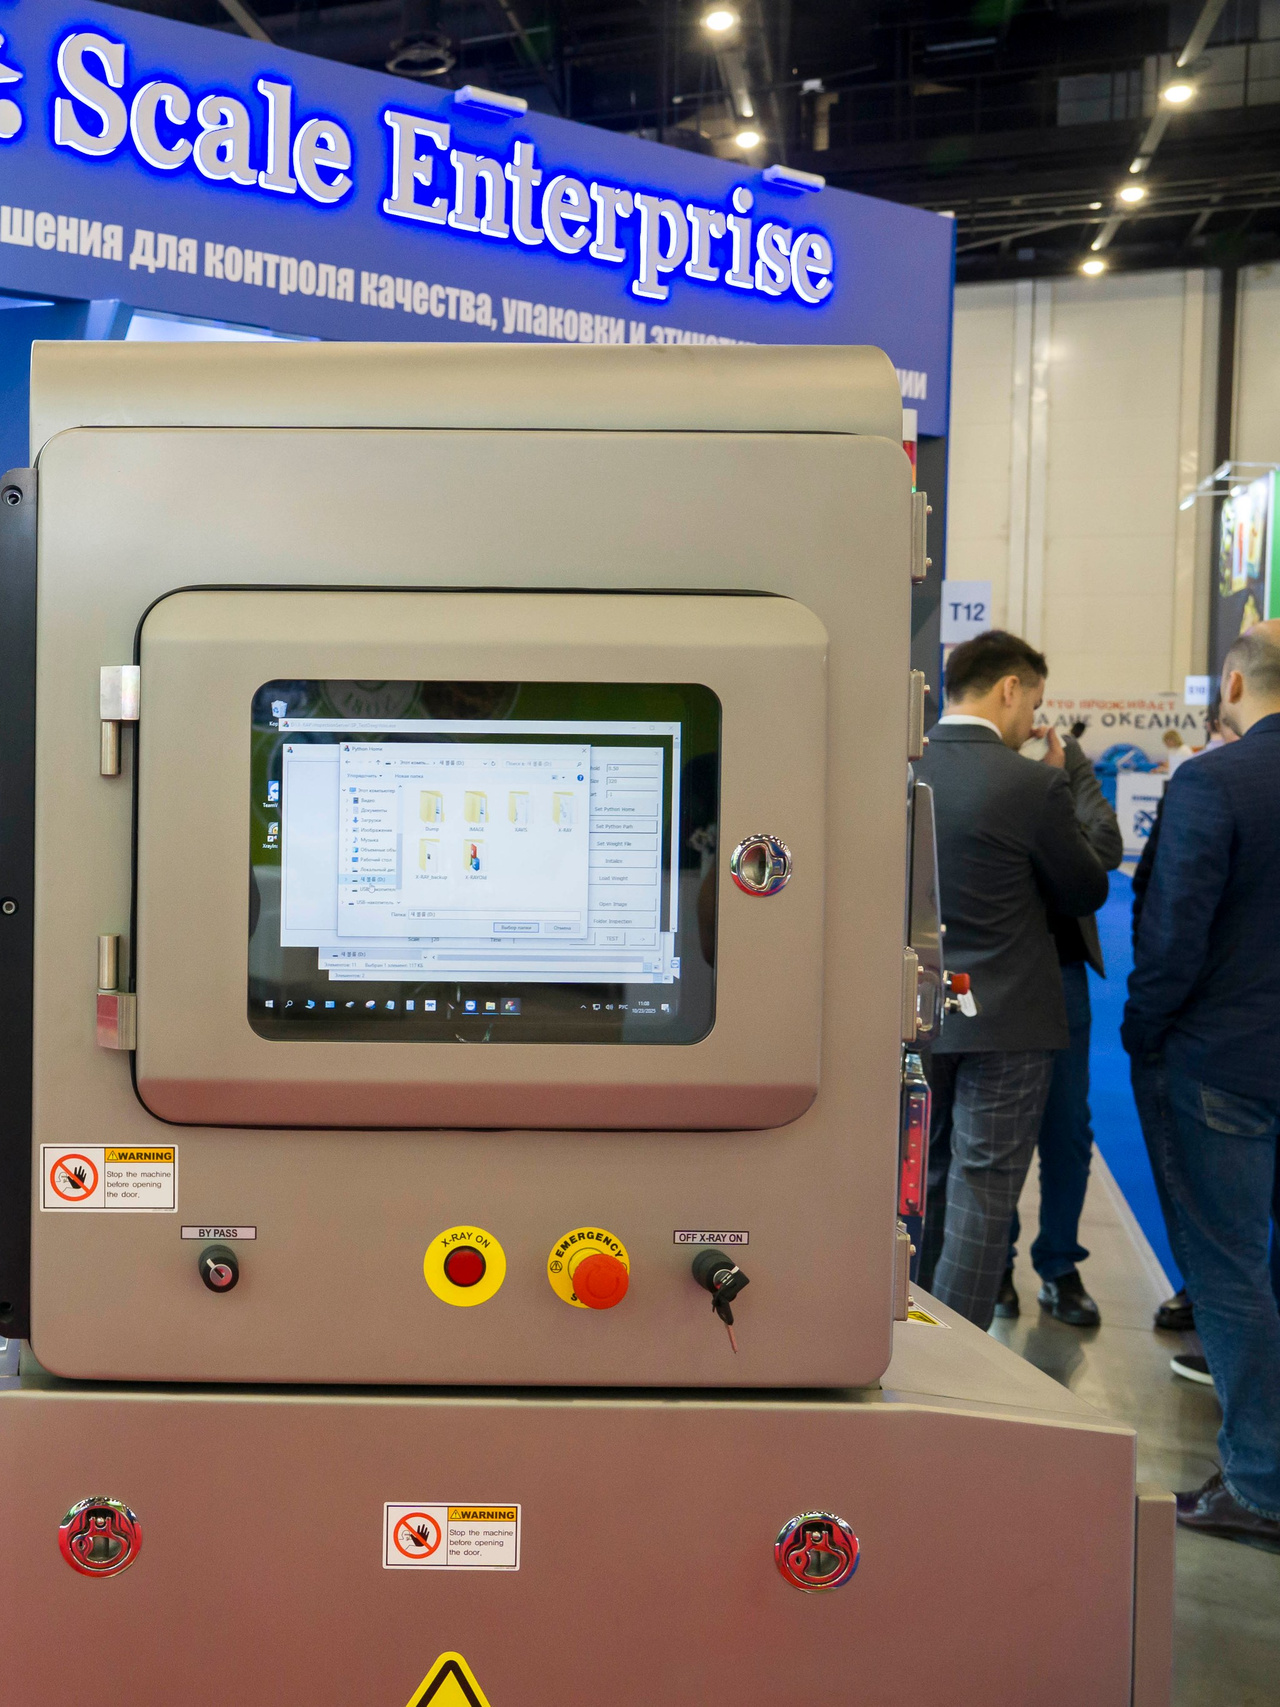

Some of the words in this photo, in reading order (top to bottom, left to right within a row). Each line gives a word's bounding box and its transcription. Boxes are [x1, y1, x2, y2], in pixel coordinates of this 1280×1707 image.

[53, 32, 352, 203] Scale
[383, 107, 835, 305] Enterprise
[129, 229, 198, 274] для
[204, 241, 354, 302] контроля
[360, 271, 498, 332] качества,
[503, 298, 625, 344] упаковки
[629, 320, 646, 344] и
[949, 603, 985, 621] T12
[118, 1152, 172, 1160] WARNING
[107, 1170, 123, 1179] Stop
[132, 1181, 162, 1189] opening
[121, 1191, 140, 1199] door.
[198, 1229, 212, 1238] BY
[213, 1229, 238, 1238] PASS
[679, 1233, 697, 1242] OFF
[699, 1234, 728, 1243] X-RAY
[730, 1234, 743, 1243] ON
[440, 1231, 473, 1248] X-RAY
[475, 1234, 491, 1249] ON
[555, 1231, 624, 1258] EMERGENCY
[461, 1511, 515, 1520] WARNING
[449, 1529, 465, 1537] Stop
[474, 1539, 504, 1547] opening
